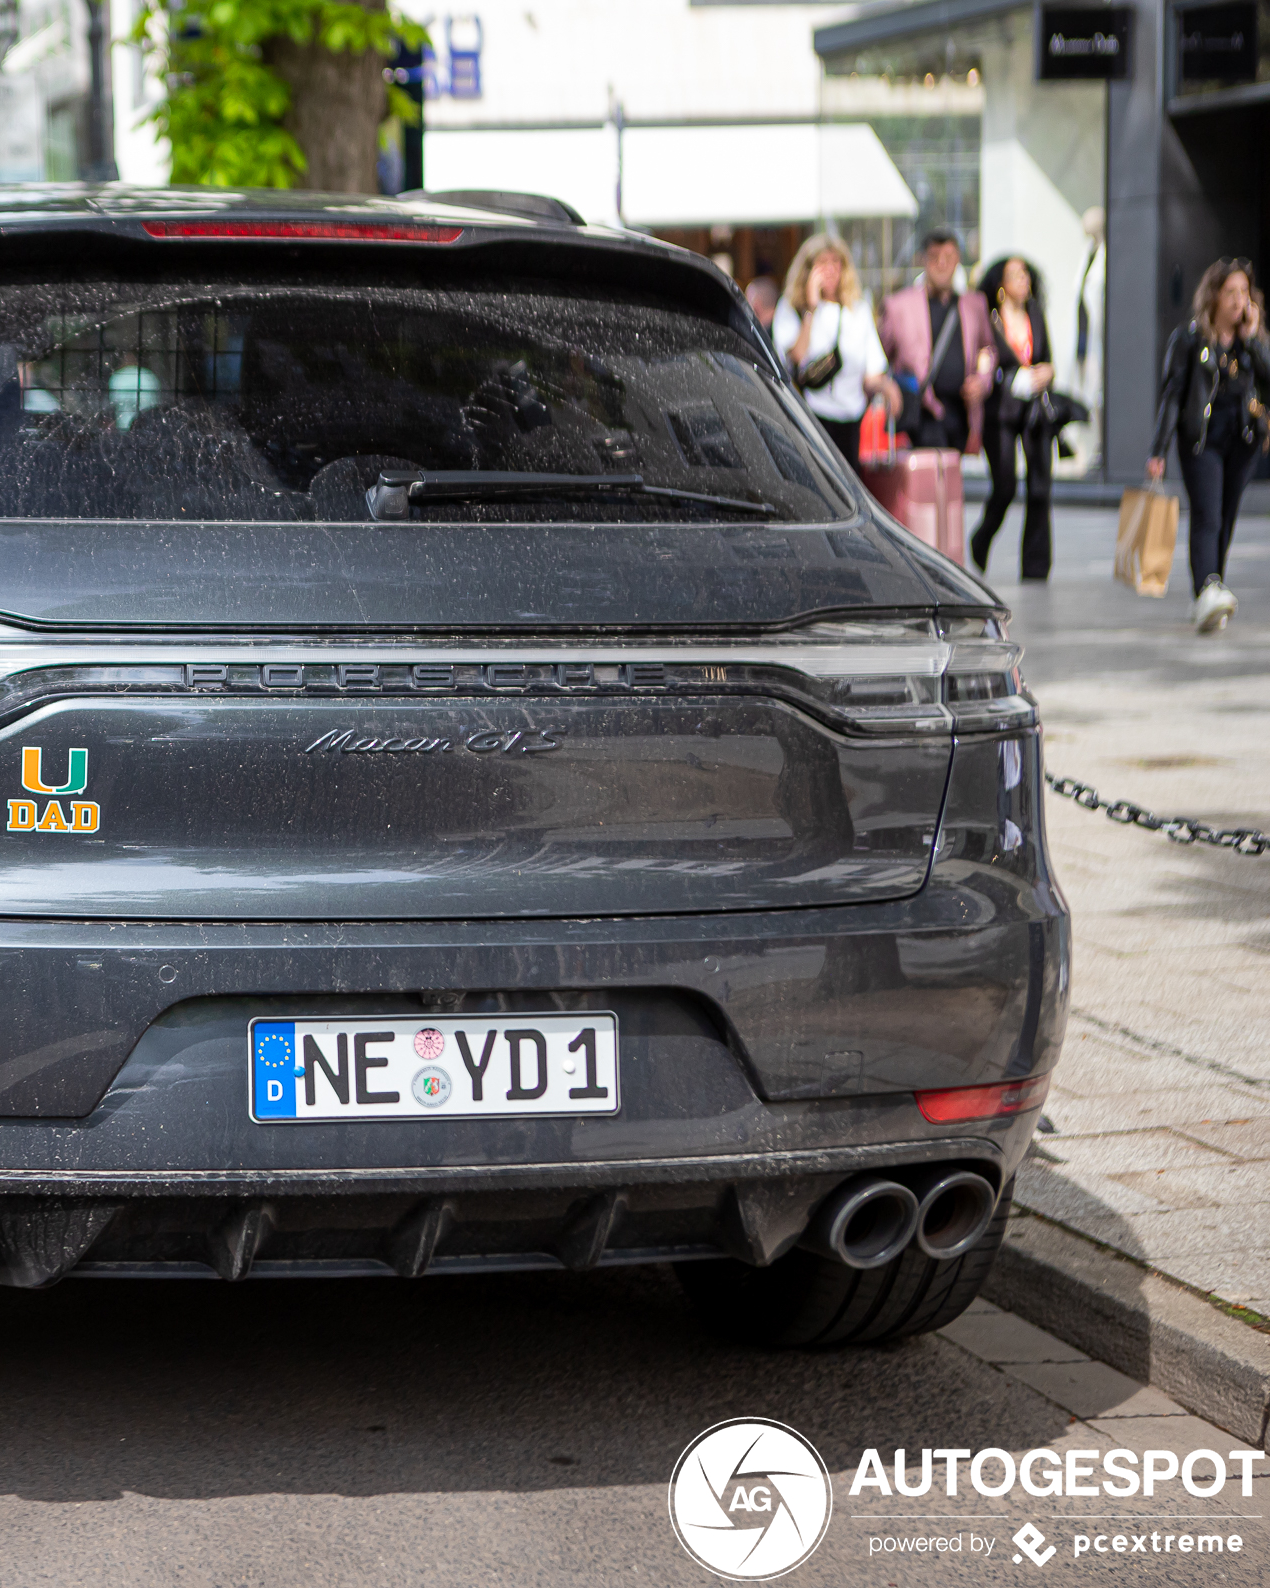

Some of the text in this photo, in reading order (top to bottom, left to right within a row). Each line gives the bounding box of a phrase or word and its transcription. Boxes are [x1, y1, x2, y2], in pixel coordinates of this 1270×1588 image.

[186, 663, 667, 688] PORSCHE
[304, 728, 568, 754] Macan GTS
[22, 746, 88, 795] U
[7, 799, 100, 834] DAD
[302, 1031, 400, 1106] NE
[267, 1080, 283, 1102] D
